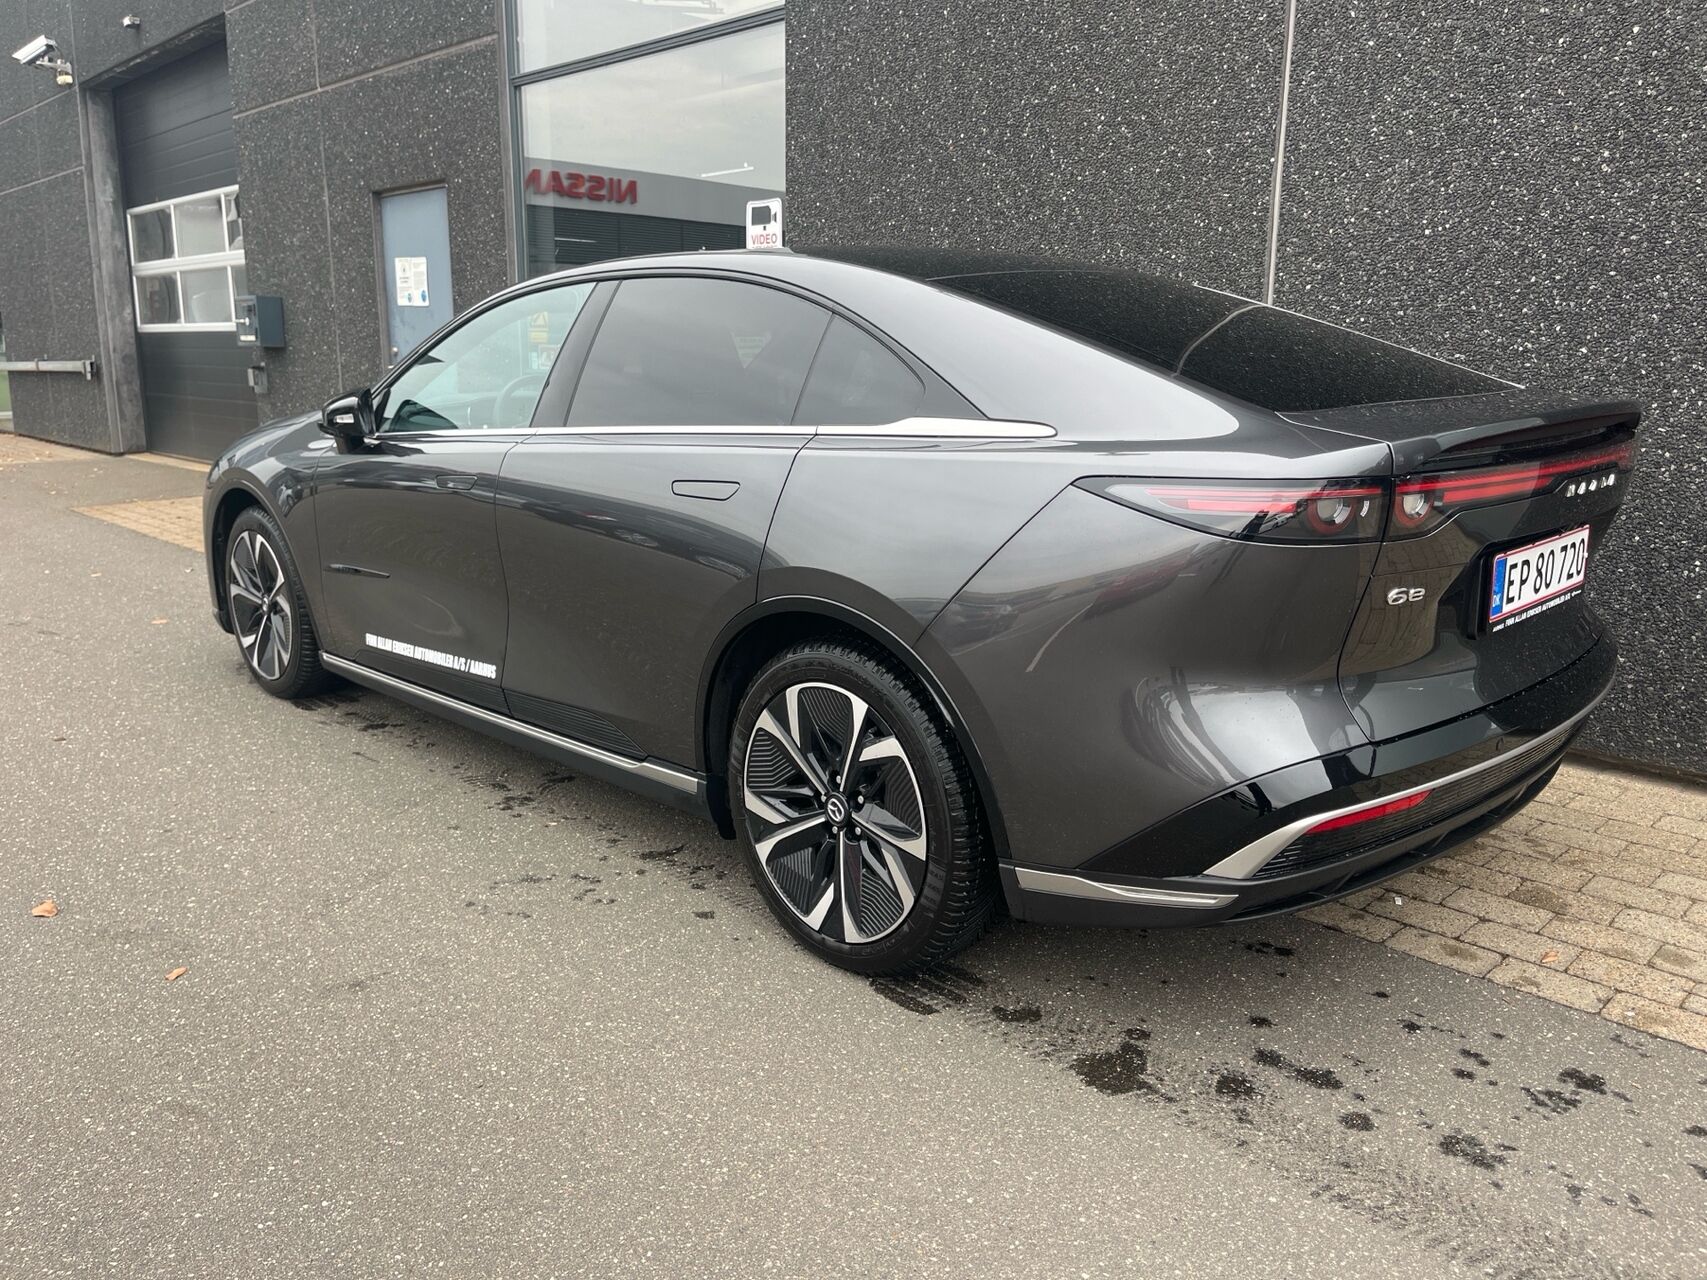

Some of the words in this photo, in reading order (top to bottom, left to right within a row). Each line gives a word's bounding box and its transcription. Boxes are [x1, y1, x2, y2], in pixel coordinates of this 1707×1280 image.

[751, 233, 778, 245] VIDEO
[1506, 559, 1531, 605] EP
[1533, 549, 1555, 595] 80
[1557, 538, 1586, 585] 720
